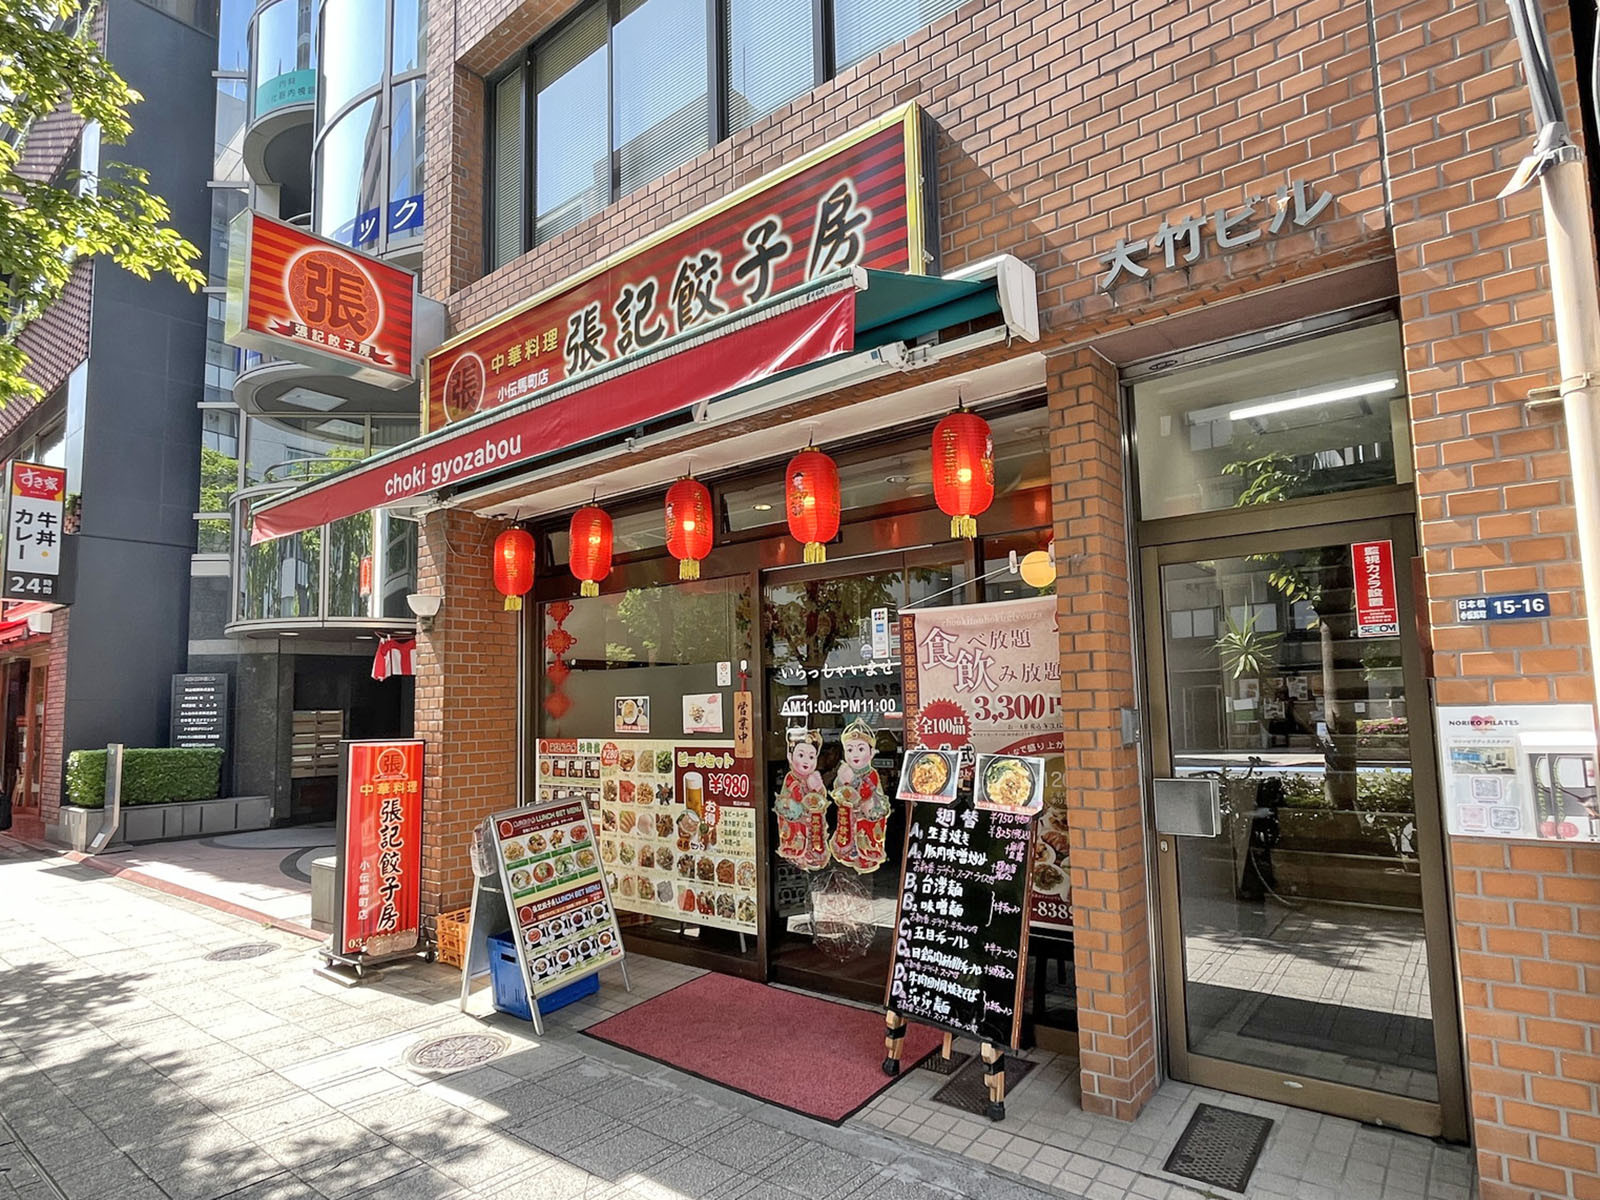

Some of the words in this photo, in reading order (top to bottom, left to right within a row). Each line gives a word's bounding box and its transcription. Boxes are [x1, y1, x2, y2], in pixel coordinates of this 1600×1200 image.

[1100, 178, 1333, 290] 大竹ビル
[566, 181, 867, 376] 張記餃子房
[306, 260, 367, 336] 張
[295, 324, 371, 357] 張記餃子房
[491, 328, 558, 374] 中華料理
[498, 368, 549, 402] 小伝馬町店
[385, 462, 426, 496] choki
[432, 434, 522, 485] gyozabou
[19, 468, 58, 491] すき家
[16, 509, 33, 560] カレー
[1364, 546, 1384, 607] 監視カメラ設置
[1459, 599, 1486, 610] 日本橋
[1494, 598, 1545, 614] 15-16
[1361, 624, 1396, 634] SECOM
[781, 660, 893, 680] いらっしゃいませ
[738, 701, 748, 744] 営業中
[920, 717, 966, 736] 全100品
[383, 755, 401, 772] 張
[678, 752, 734, 768] ビールセット
[360, 780, 418, 796] 中華料理
[708, 773, 749, 797] ¥980
[536, 812, 556, 822] LUNCH
[378, 799, 403, 931] 張記餃子房
[358, 860, 370, 920] 小伝馬町店
[922, 874, 964, 898] 台湾麺
[555, 894, 575, 903] LUNCH
